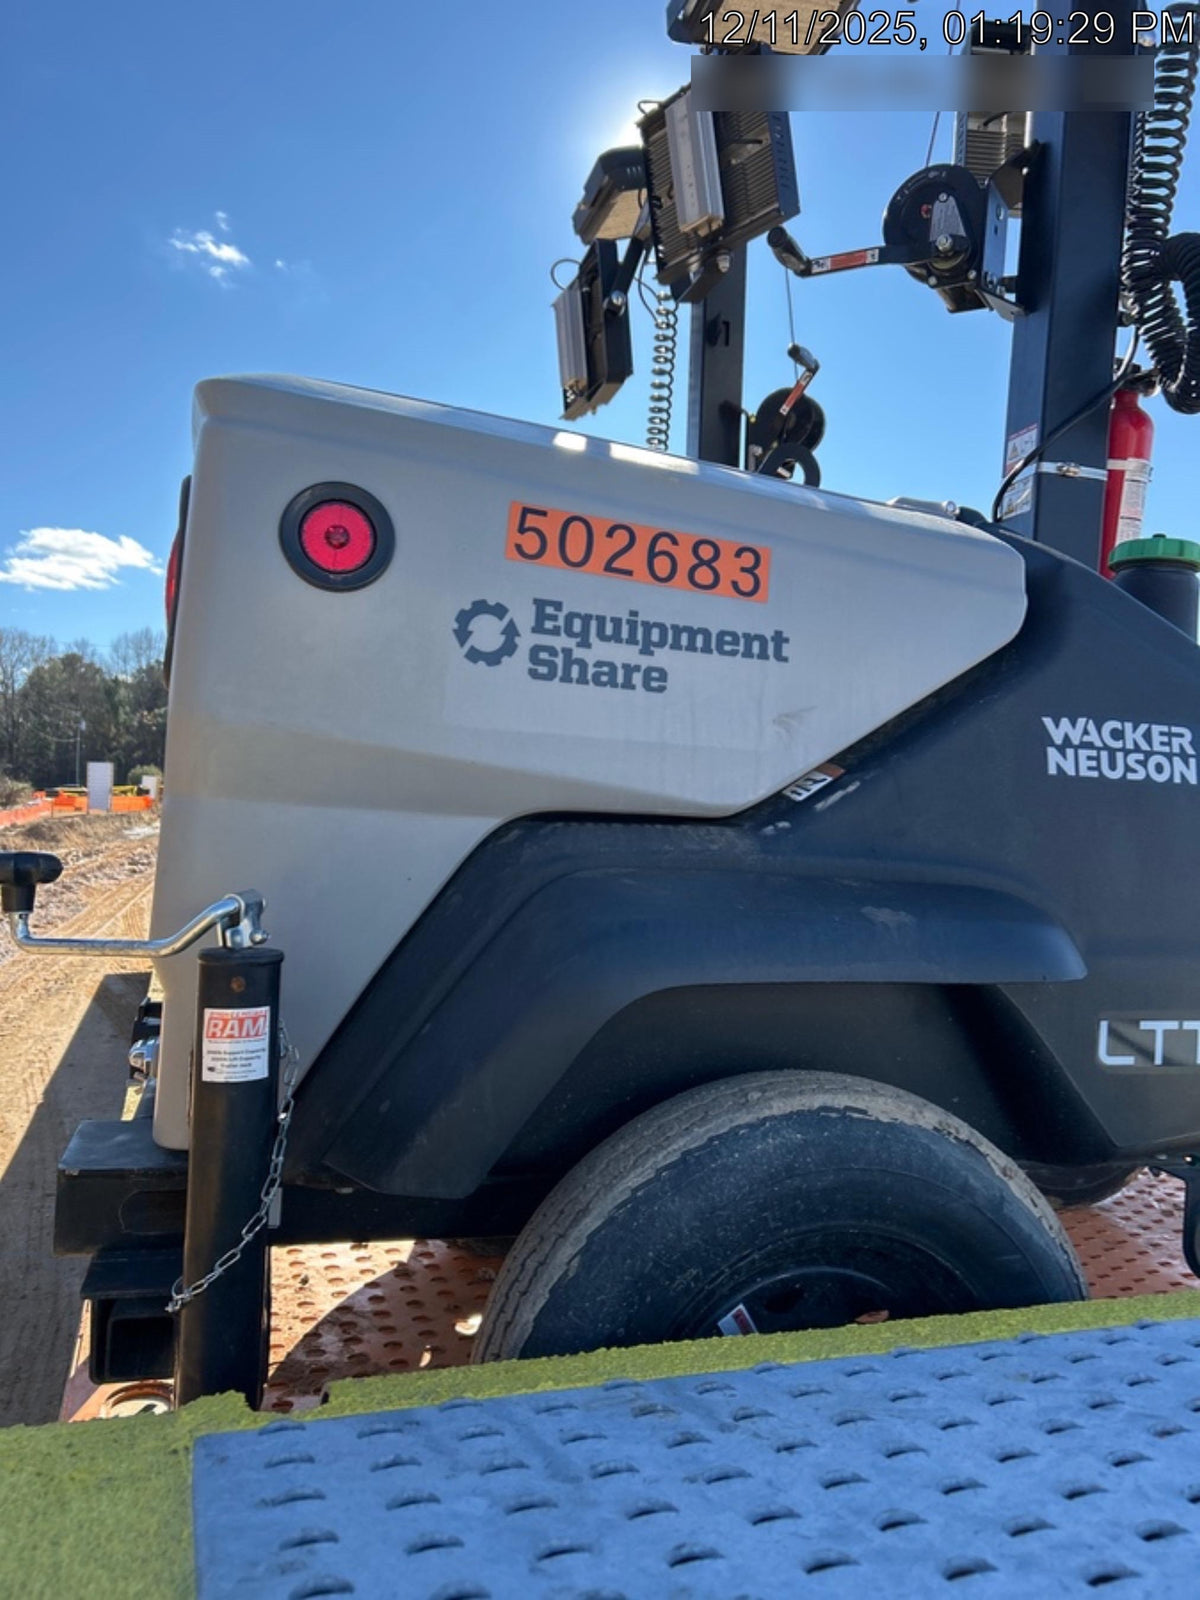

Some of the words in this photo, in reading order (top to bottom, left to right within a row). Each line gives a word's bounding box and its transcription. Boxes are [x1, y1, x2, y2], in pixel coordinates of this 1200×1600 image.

[514, 506, 762, 598] 502683
[531, 597, 790, 663] Equipment
[528, 643, 668, 693] Share
[1041, 716, 1196, 754] WACKER
[1046, 747, 1198, 785] NEUSON
[207, 1017, 266, 1037] RAM
